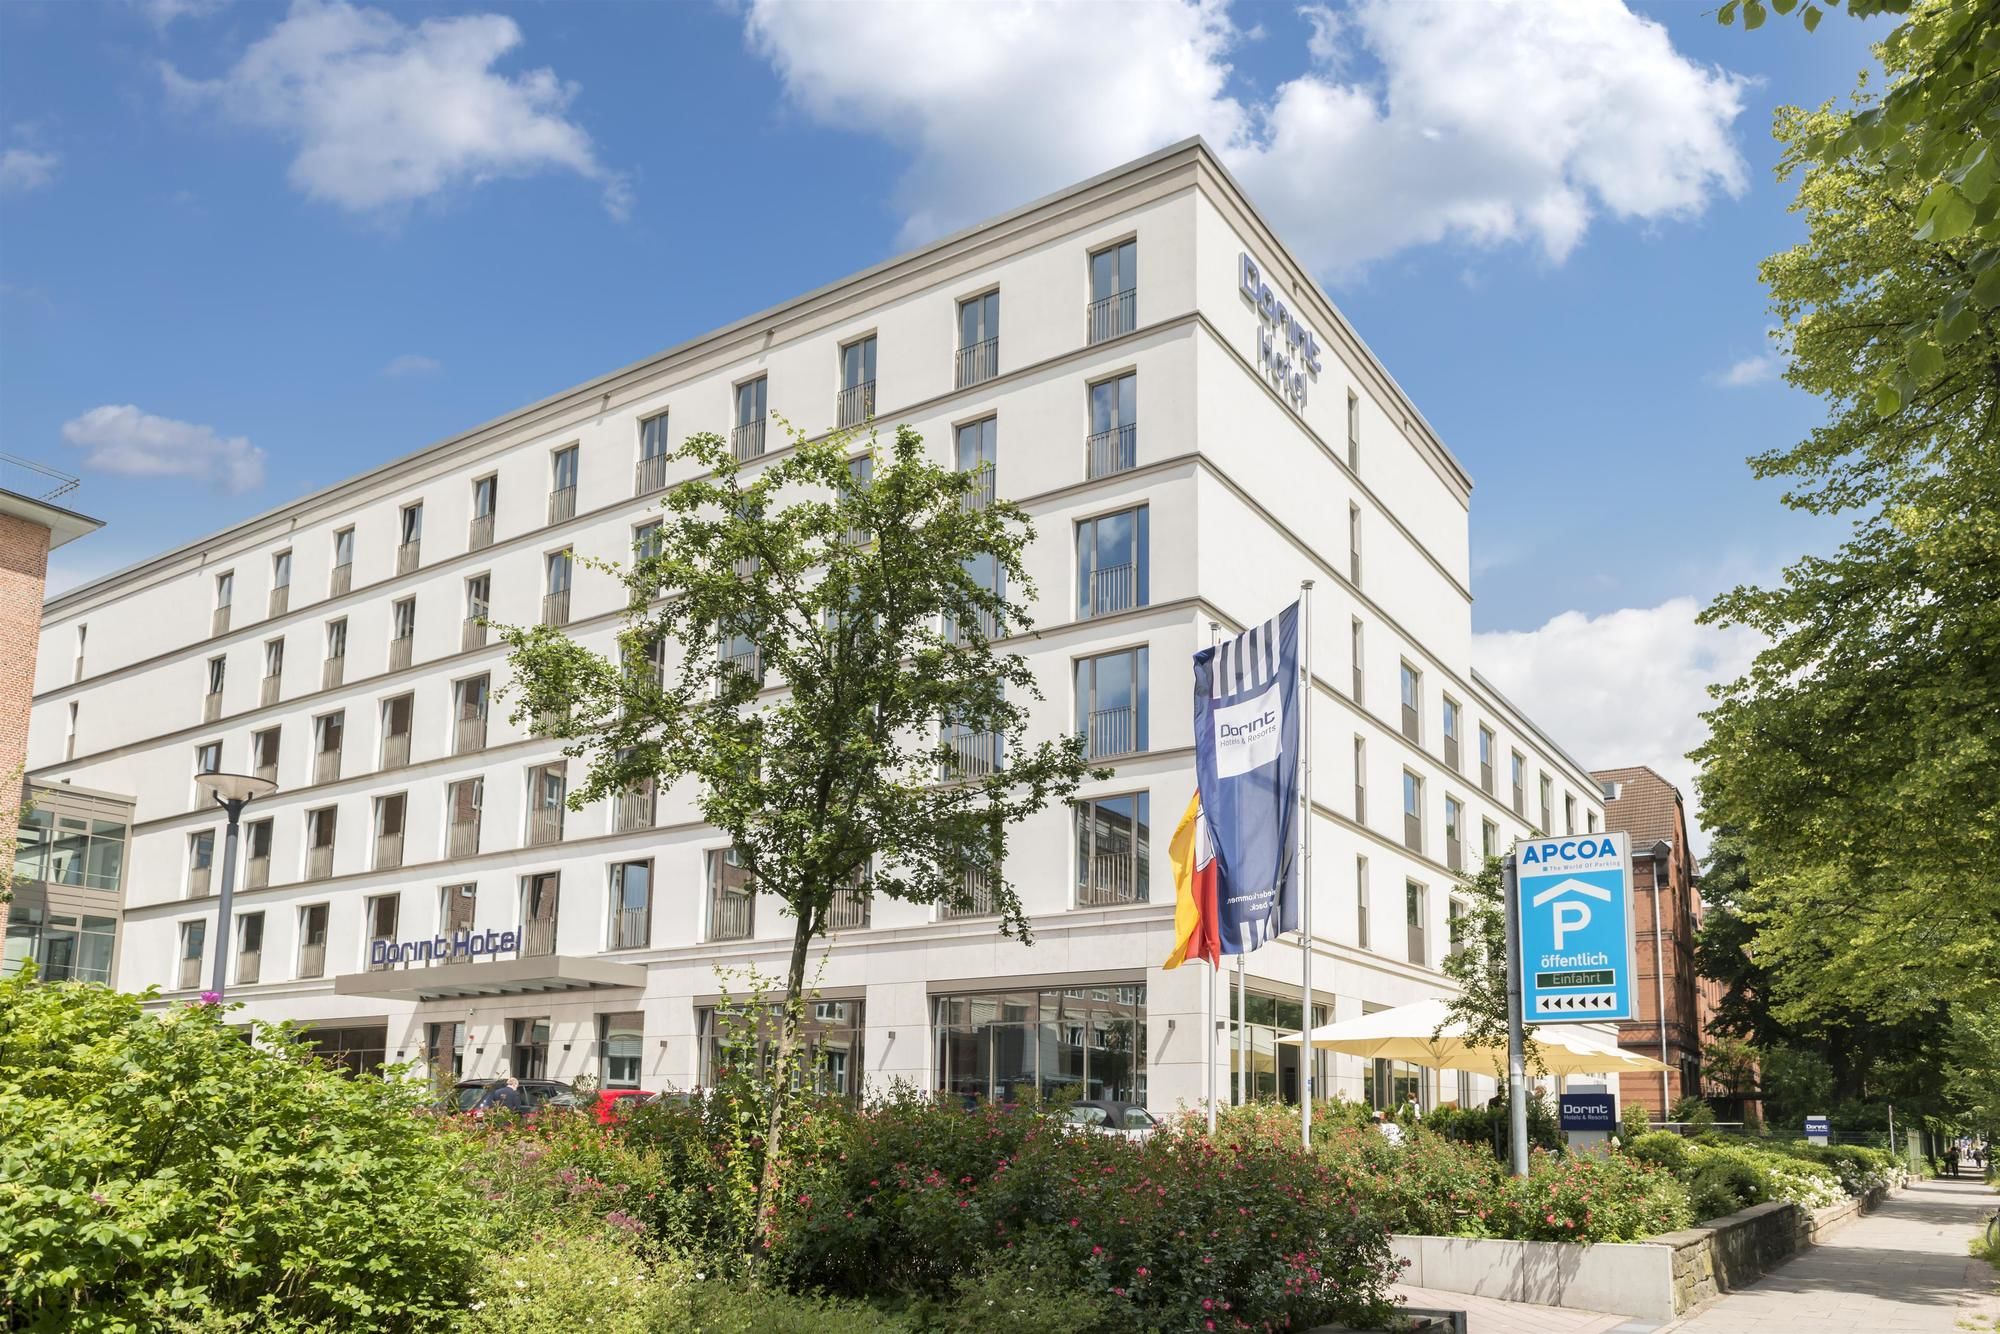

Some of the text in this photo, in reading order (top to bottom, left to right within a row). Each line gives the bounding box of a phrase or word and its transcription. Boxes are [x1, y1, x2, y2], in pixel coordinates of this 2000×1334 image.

[1239, 252, 1322, 374] Dorint
[1257, 325, 1307, 408] Hotel
[1220, 710, 1276, 738] Dorint
[1220, 737, 1241, 748] Hotels
[1247, 724, 1276, 743] Resorts
[1522, 838, 1617, 865] APCOA
[1594, 859, 1621, 868] Parking
[1552, 900, 1592, 951] P
[371, 925, 522, 964] Dorint Hotel
[1541, 951, 1608, 968] öffentlich
[1552, 972, 1601, 985] Einfahrt
[1563, 1104, 1608, 1114] Dorint
